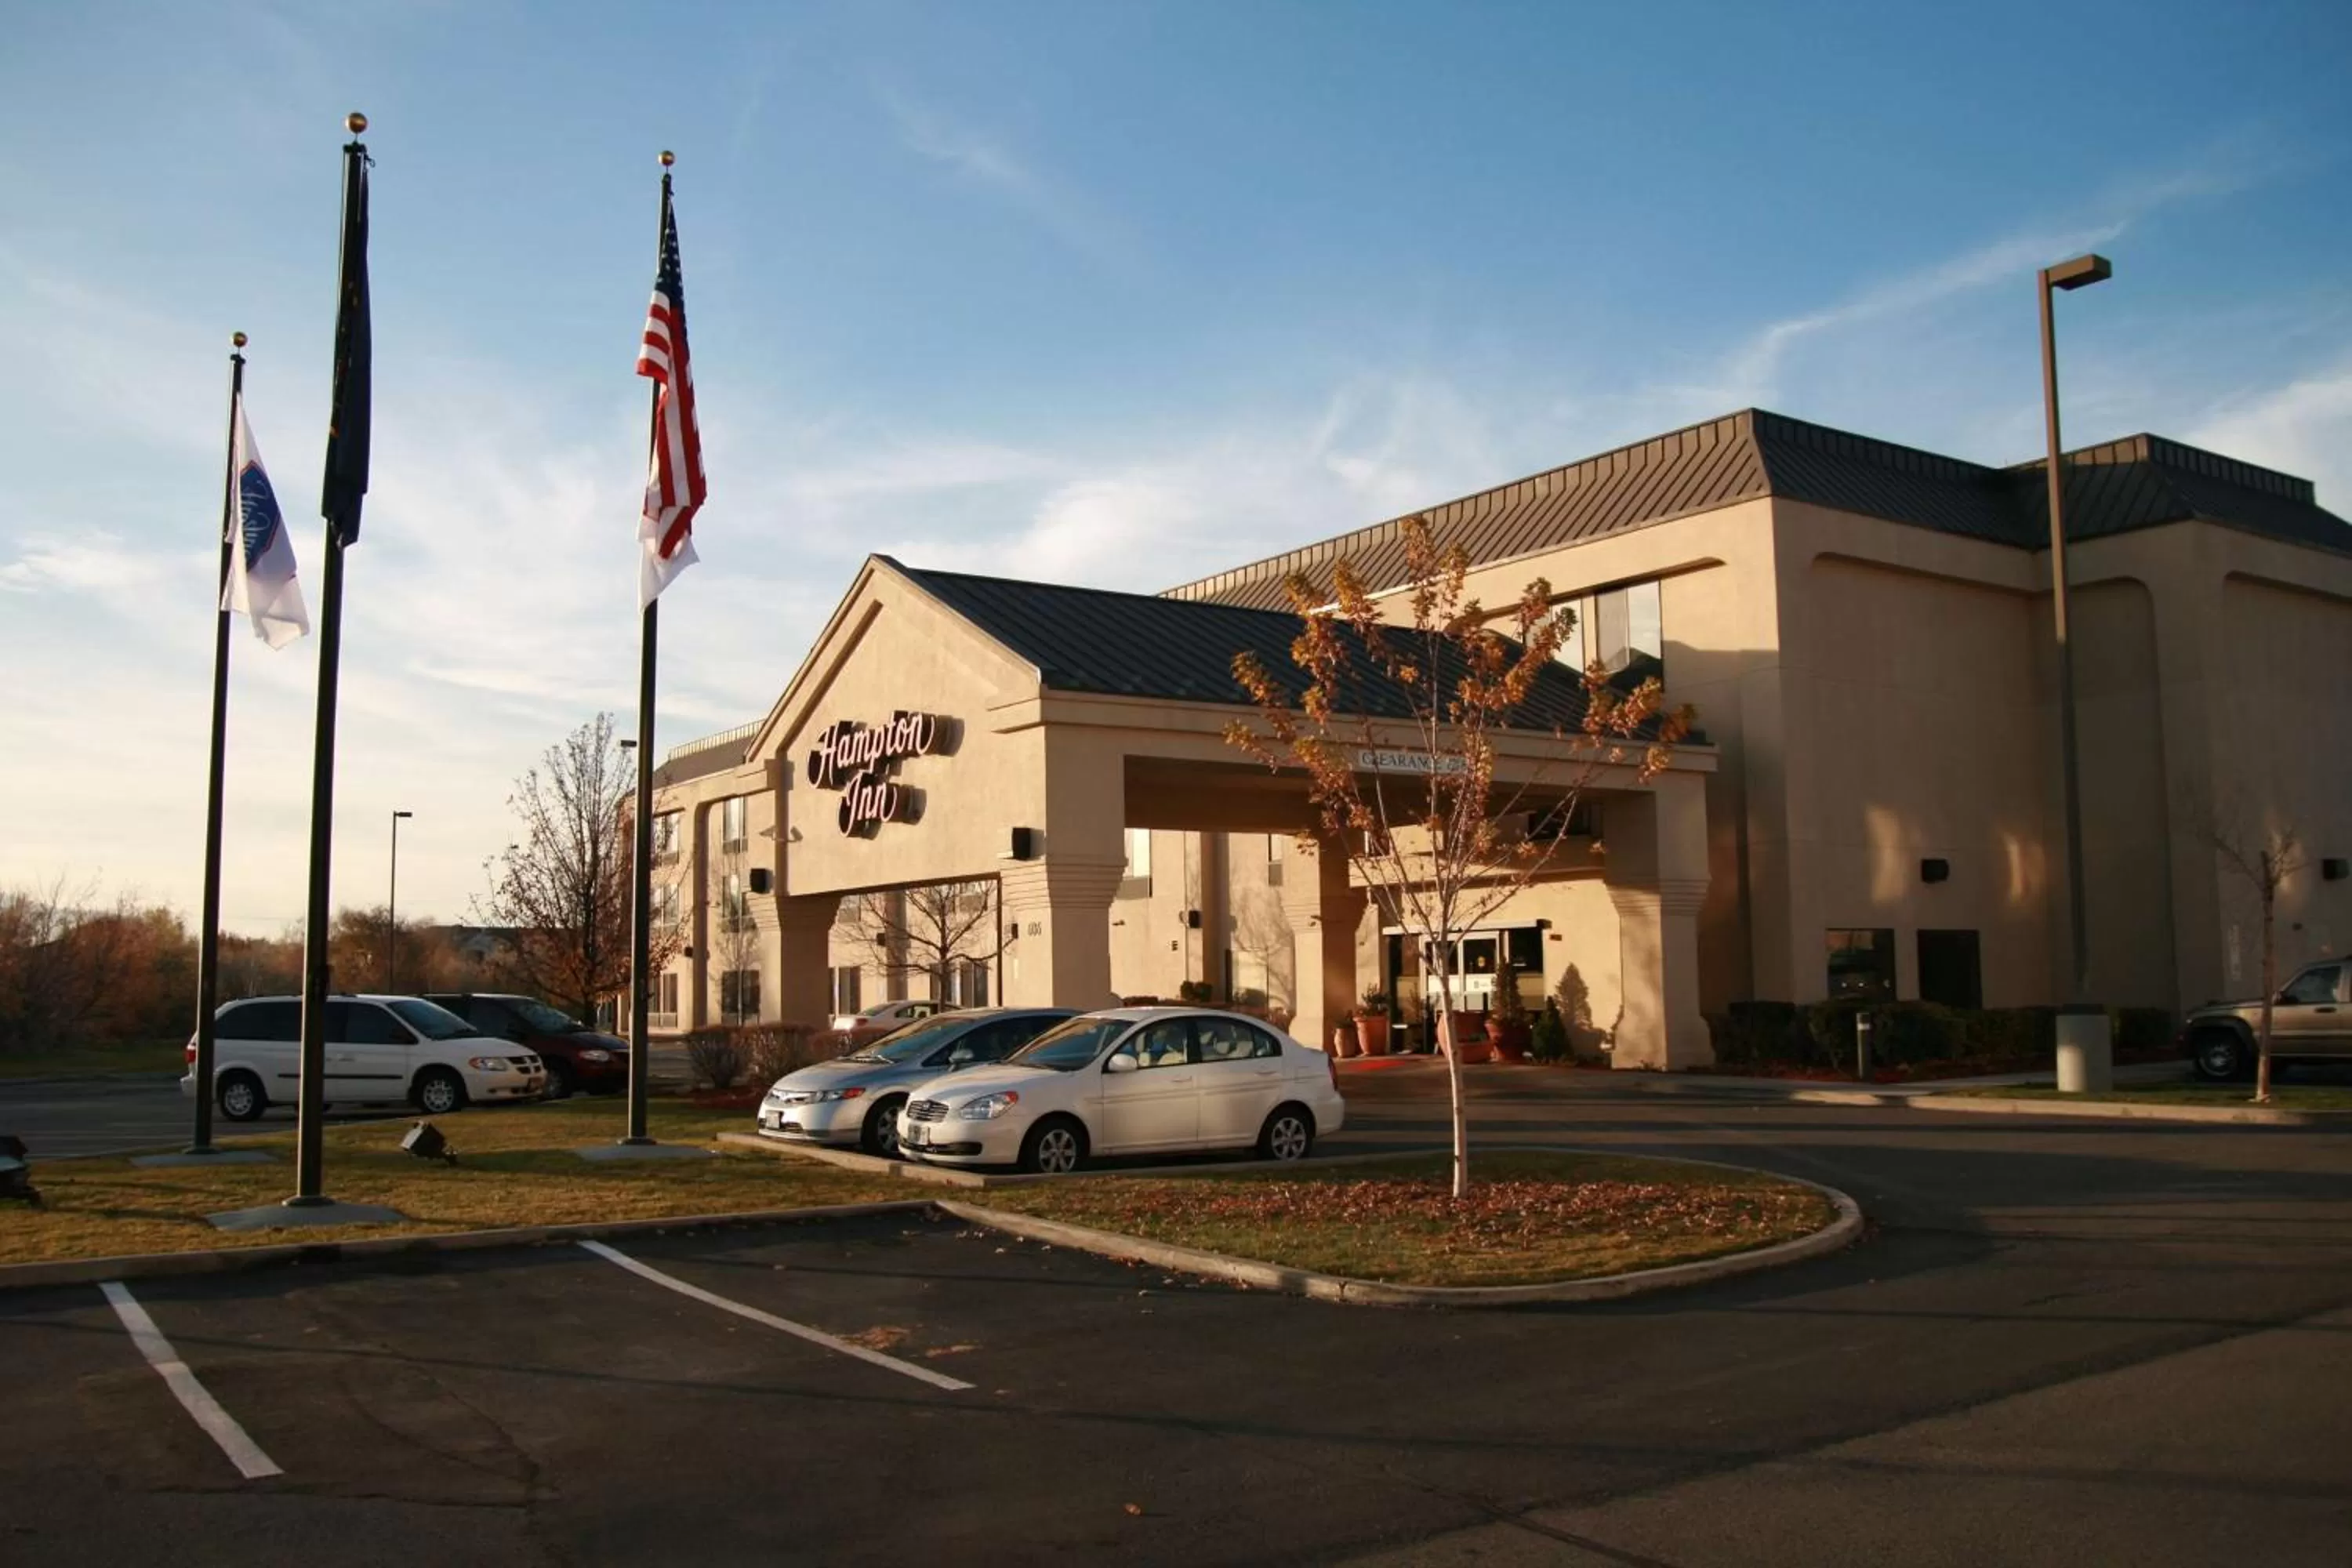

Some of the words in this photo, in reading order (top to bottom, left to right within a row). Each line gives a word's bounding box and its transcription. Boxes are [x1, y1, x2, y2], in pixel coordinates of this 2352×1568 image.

[808, 711, 936, 789] Hampton
[1362, 752, 1443, 770] CEARANE
[838, 769, 898, 837] Inn
